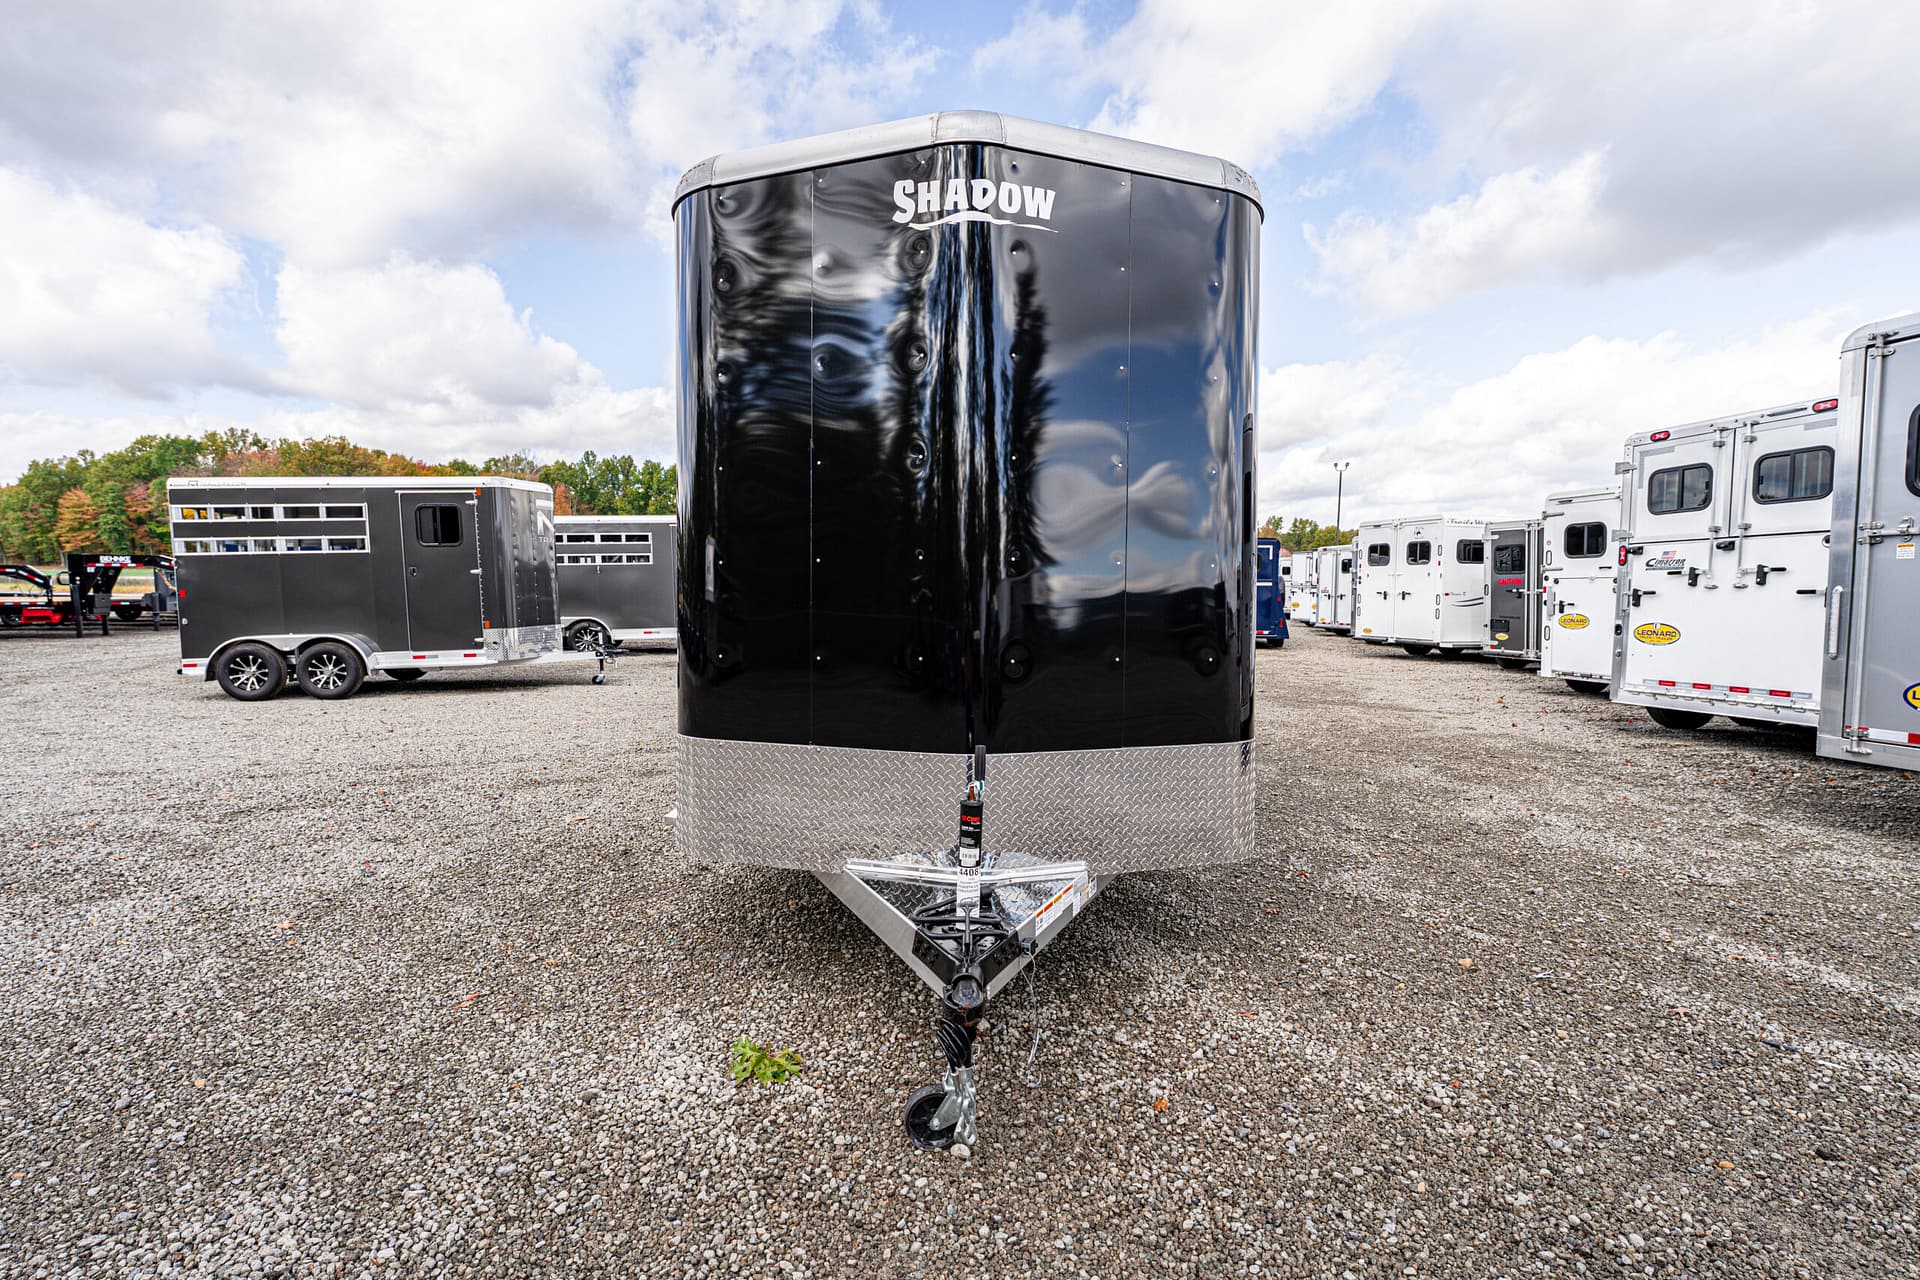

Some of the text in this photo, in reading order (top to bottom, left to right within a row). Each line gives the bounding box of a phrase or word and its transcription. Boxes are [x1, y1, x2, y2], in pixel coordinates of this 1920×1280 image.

[892, 178, 1056, 223] SHADOW
[99, 555, 131, 564] BEHNKE
[1637, 629, 1677, 638] LEONARD
[958, 867, 979, 877] 4408
